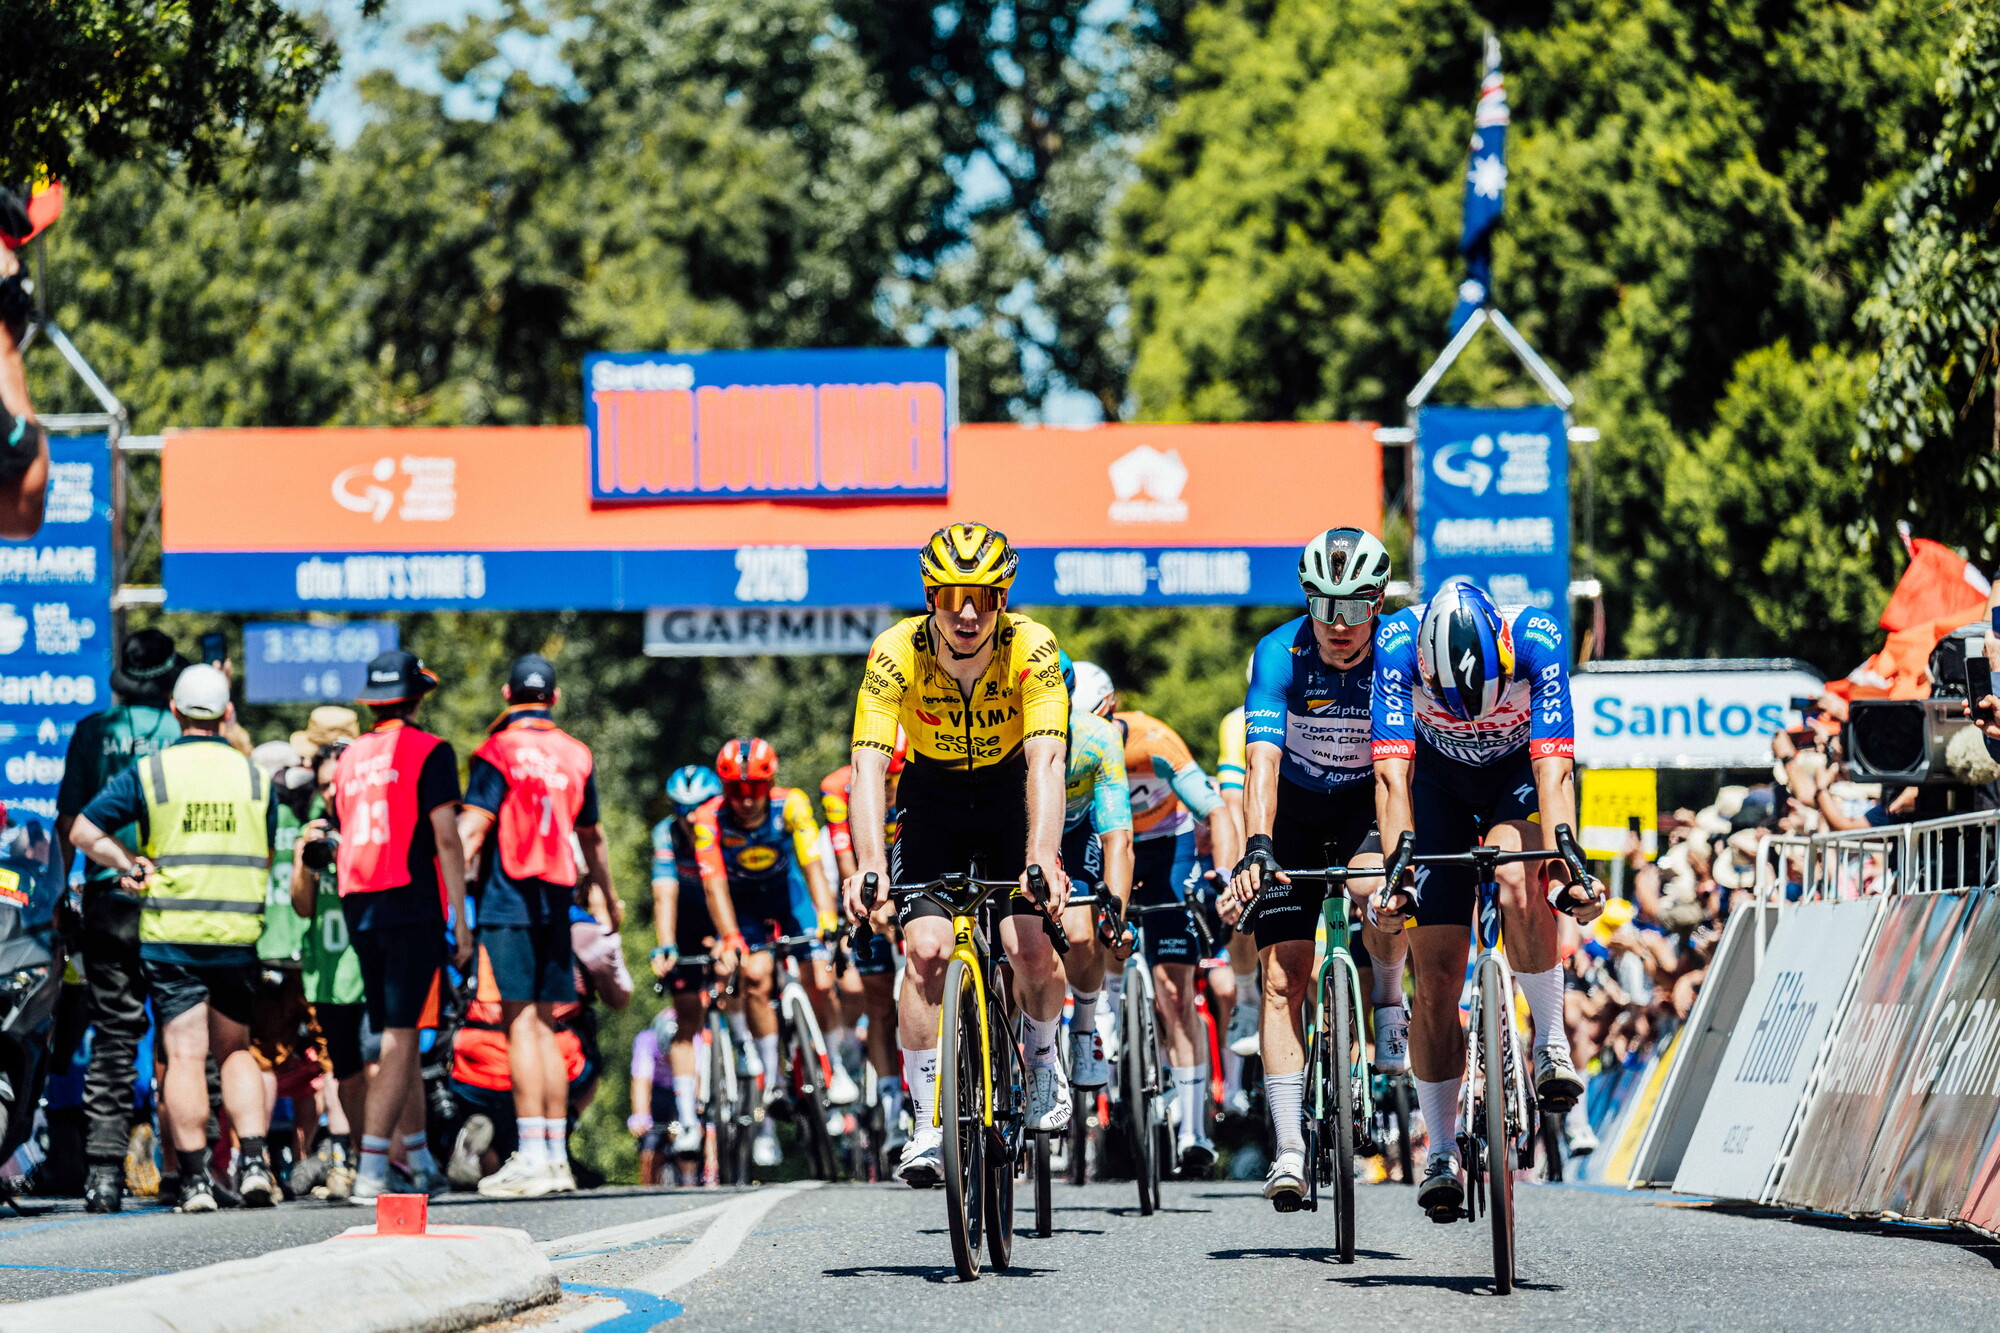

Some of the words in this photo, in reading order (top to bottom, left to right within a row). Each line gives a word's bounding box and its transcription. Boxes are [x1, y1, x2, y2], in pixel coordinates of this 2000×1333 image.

[0, 545, 96, 573] DELAIDE
[662, 609, 879, 646] GARMIN
[1377, 620, 1410, 648] BORA
[1528, 616, 1562, 645] BORA
[1027, 640, 1058, 664] VISM
[875, 652, 908, 693] VISMA
[0, 671, 96, 705] antos
[1383, 667, 1404, 726] BOSS
[1541, 663, 1562, 724] BOSS
[948, 706, 1018, 728] VISMA
[1327, 705, 1370, 718] Ziptra
[1593, 697, 1786, 737] Santos
[1302, 733, 1335, 742] CMA
[1311, 749, 1331, 760] VAN
[1332, 754, 1360, 762] RYSEL
[187, 803, 234, 820] SPORTS
[182, 819, 237, 834] MEDICINE
[1263, 891, 1290, 900] HIERY
[1265, 906, 1302, 915] DECATHLON
[1734, 972, 1818, 1084] Hilton
[1824, 1001, 1914, 1098] GARMIN
